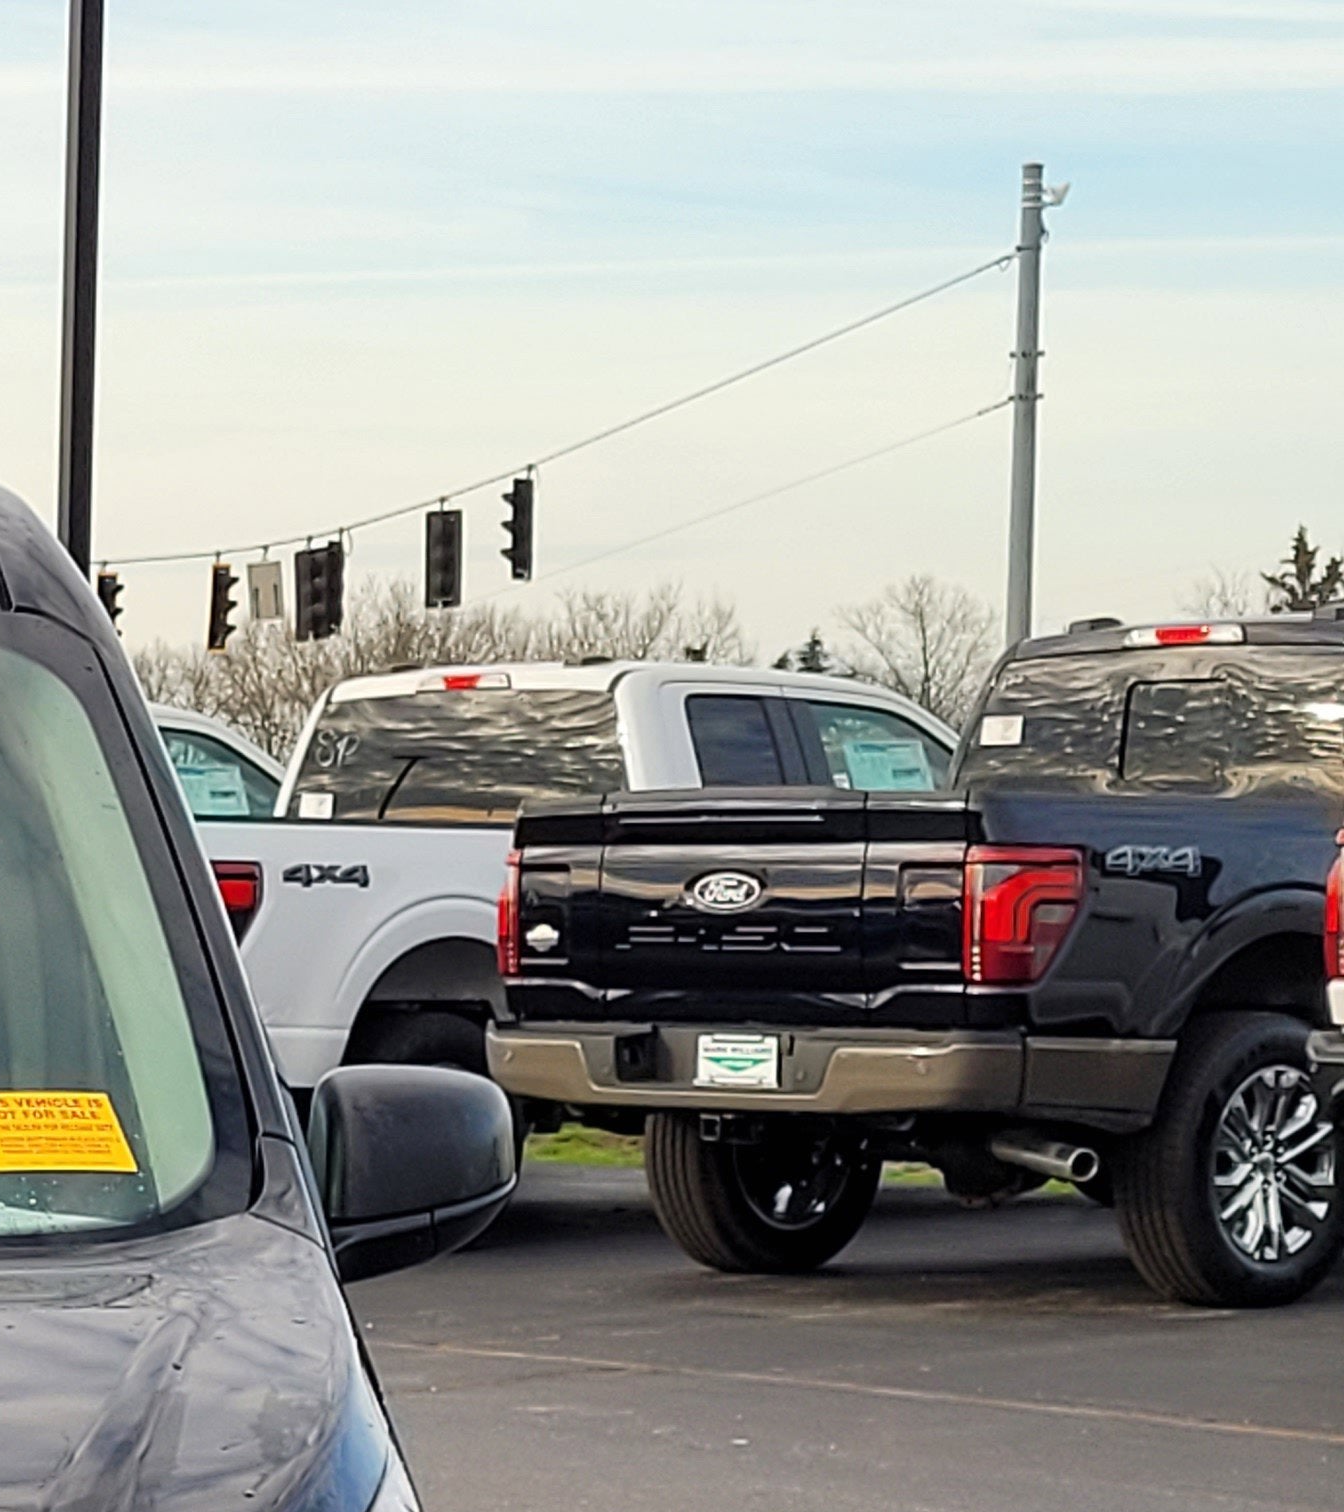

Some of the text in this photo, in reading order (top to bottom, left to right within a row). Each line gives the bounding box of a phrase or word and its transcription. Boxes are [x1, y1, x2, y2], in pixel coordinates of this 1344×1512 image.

[704, 877, 750, 902] Ford
[13, 1097, 85, 1108] VEHICLE
[87, 1098, 103, 1108] IS
[21, 1109, 56, 1120] FOR
[59, 1109, 102, 1121] SALE
